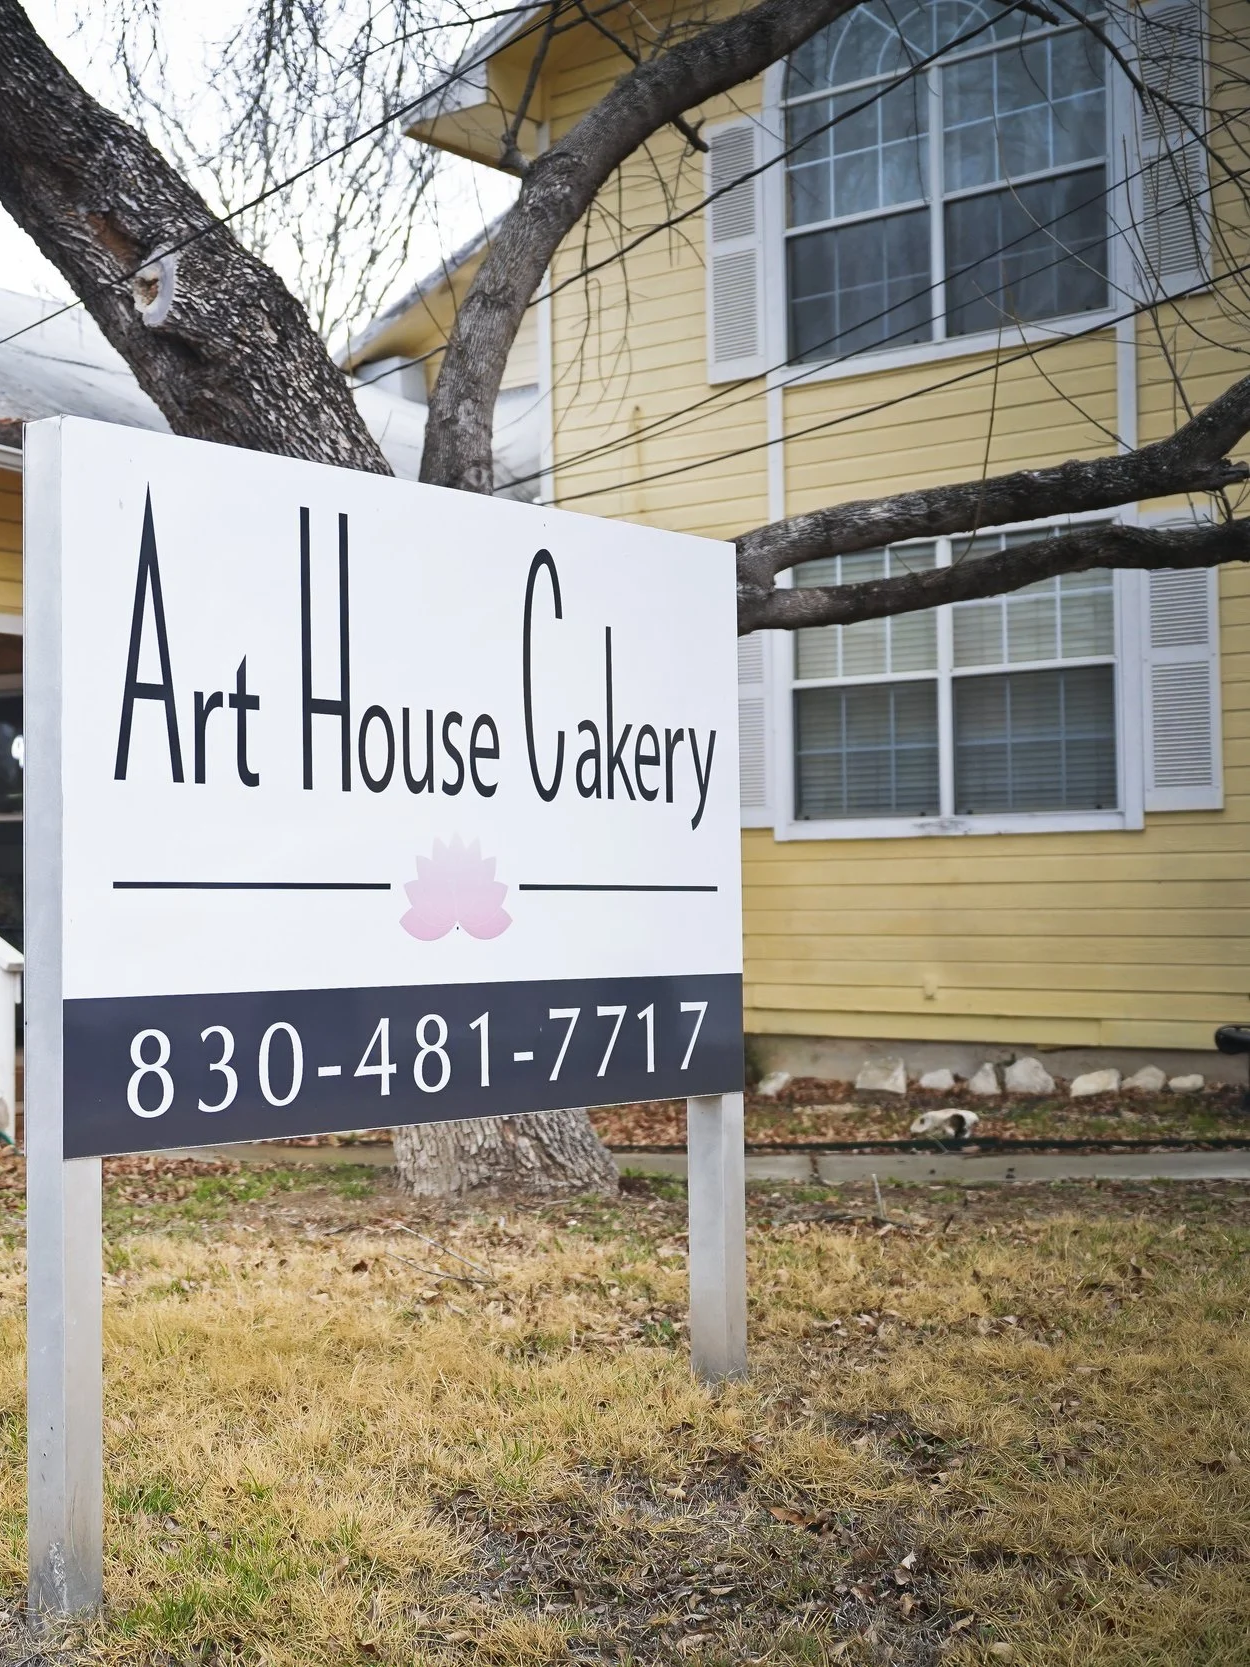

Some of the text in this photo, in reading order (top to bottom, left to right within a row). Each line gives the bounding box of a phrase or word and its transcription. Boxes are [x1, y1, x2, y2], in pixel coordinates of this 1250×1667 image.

[113, 482, 717, 831] Art House Cakery
[126, 1001, 709, 1119] 830-481-7717
